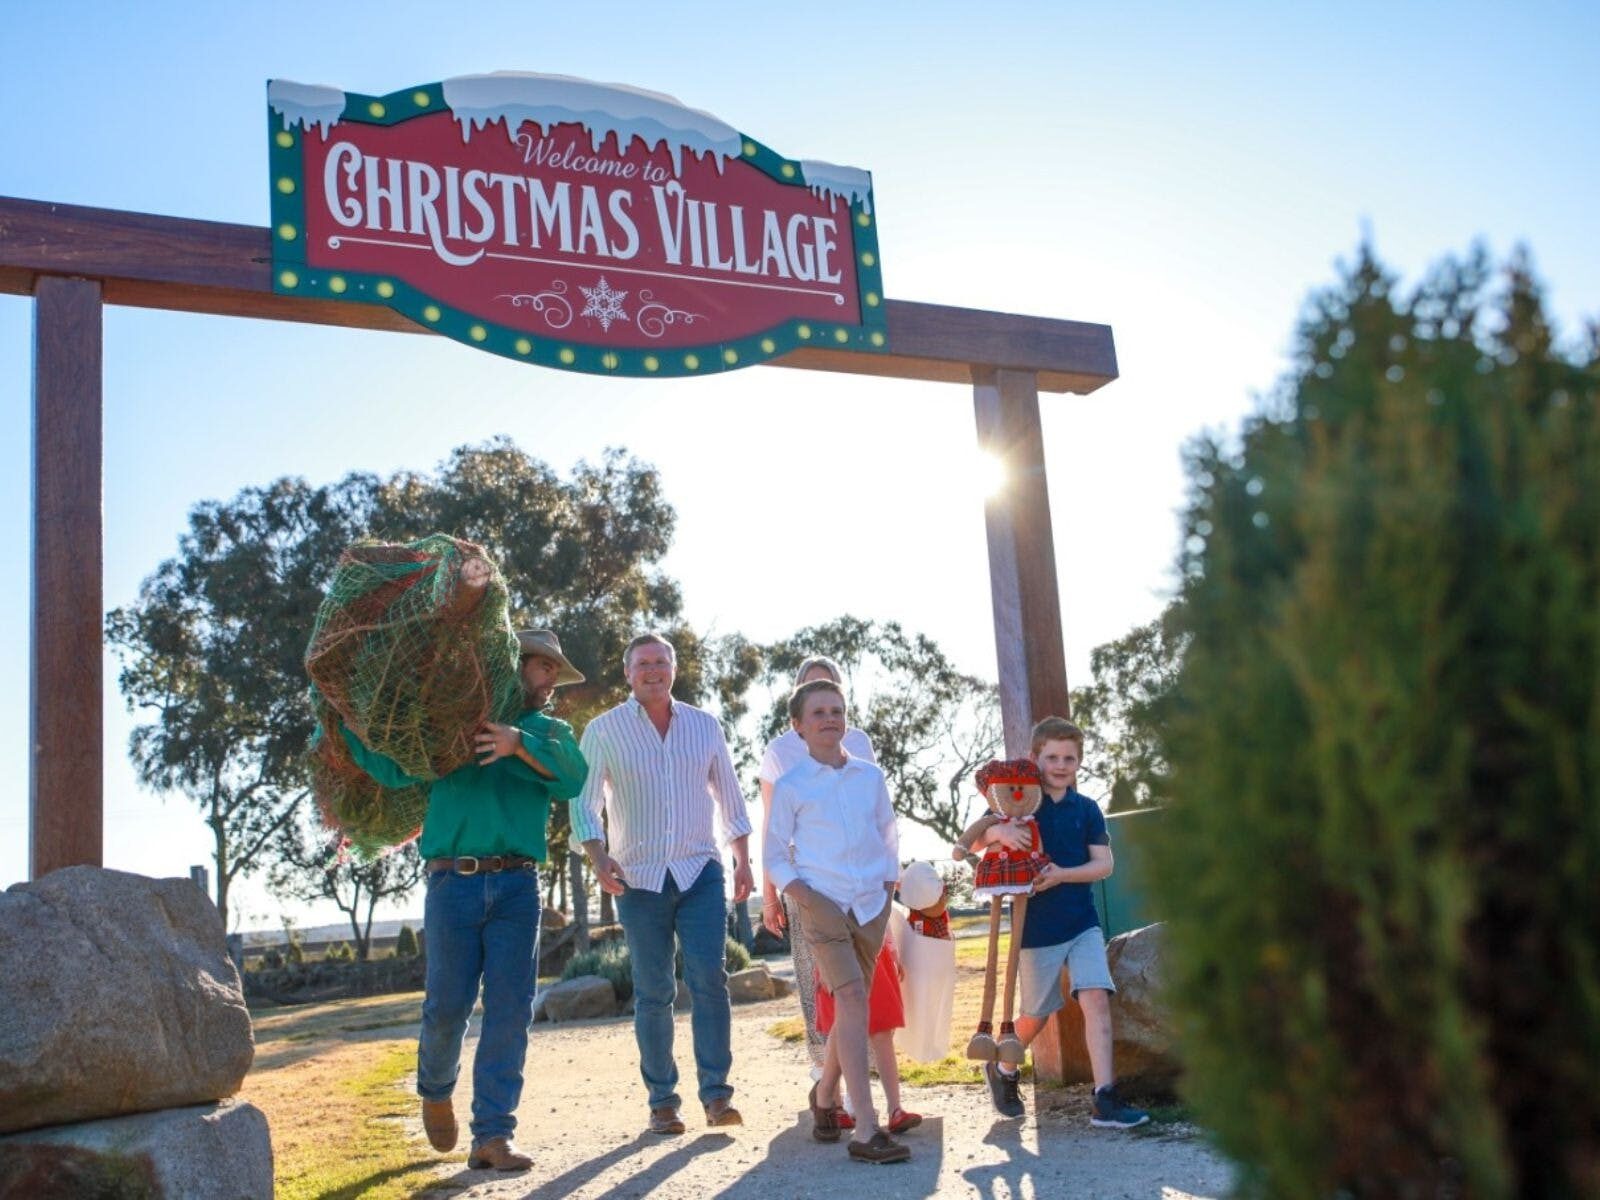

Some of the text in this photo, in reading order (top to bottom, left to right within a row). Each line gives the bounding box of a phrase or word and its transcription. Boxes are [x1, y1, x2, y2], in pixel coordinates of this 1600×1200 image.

[516, 133, 671, 182] Welcome to
[323, 141, 842, 284] CHRISTMAS VILLAGE
